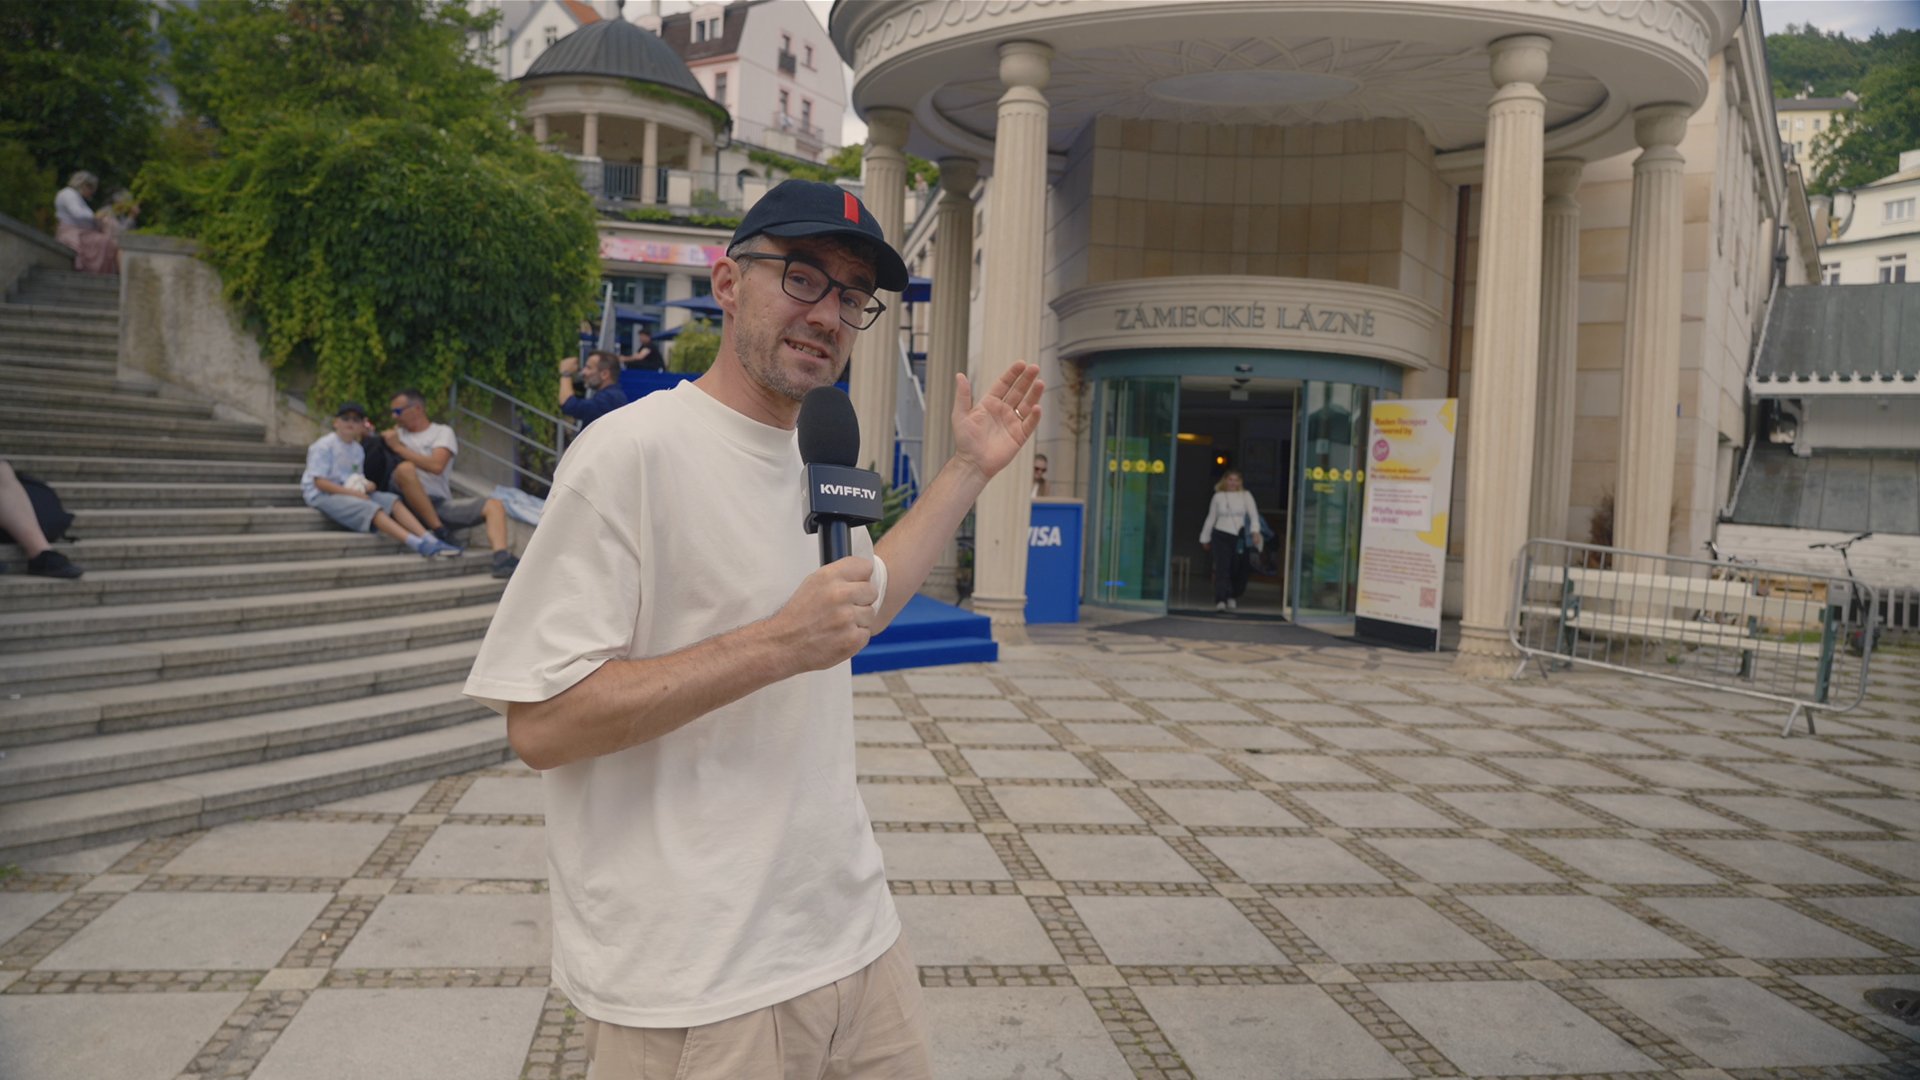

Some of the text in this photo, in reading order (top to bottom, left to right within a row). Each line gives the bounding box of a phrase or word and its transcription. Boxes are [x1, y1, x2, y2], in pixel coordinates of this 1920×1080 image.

[1114, 301, 1375, 337] ZÁMECKÉ LÁZNĚ
[820, 483, 877, 501] KVIFF.TV
